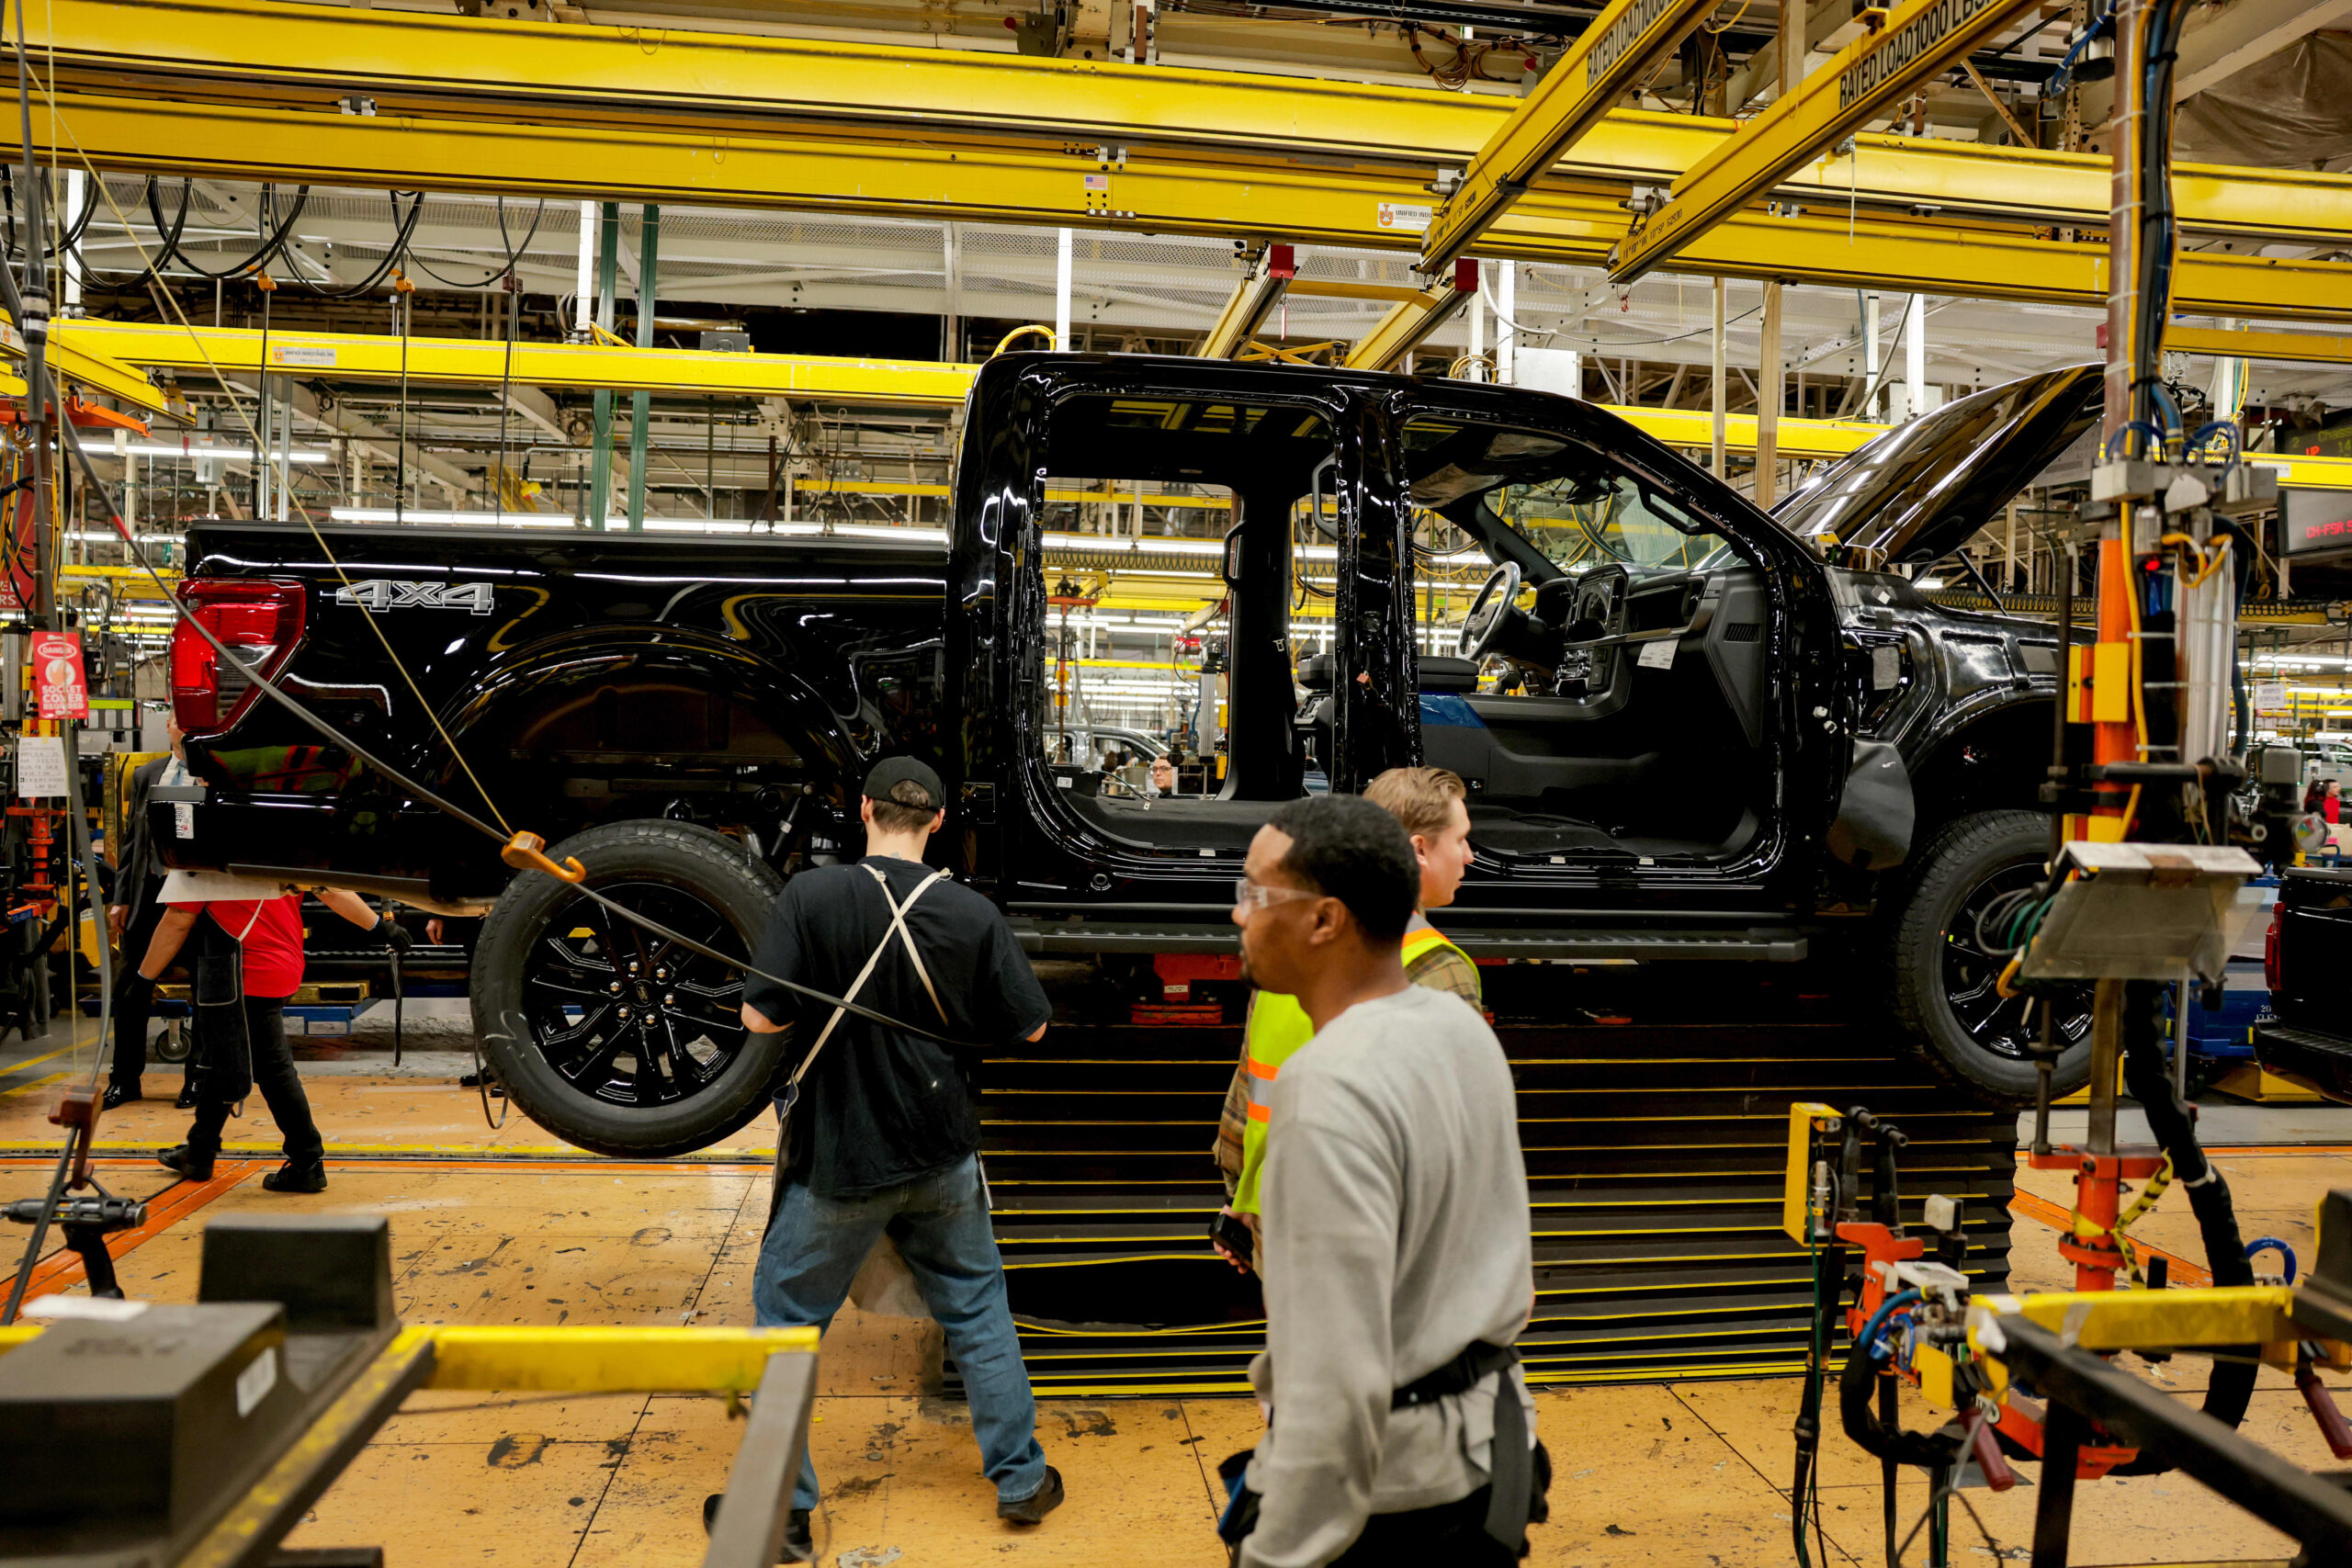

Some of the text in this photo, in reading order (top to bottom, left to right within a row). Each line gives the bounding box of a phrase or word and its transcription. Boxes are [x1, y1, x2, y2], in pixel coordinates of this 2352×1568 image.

[1588, 30, 1614, 89] RATED
[1617, 2, 1640, 58] LOAD
[1840, 0, 1990, 110] RATED LOAD 1000 LB.
[42, 694, 84, 703] COVER
